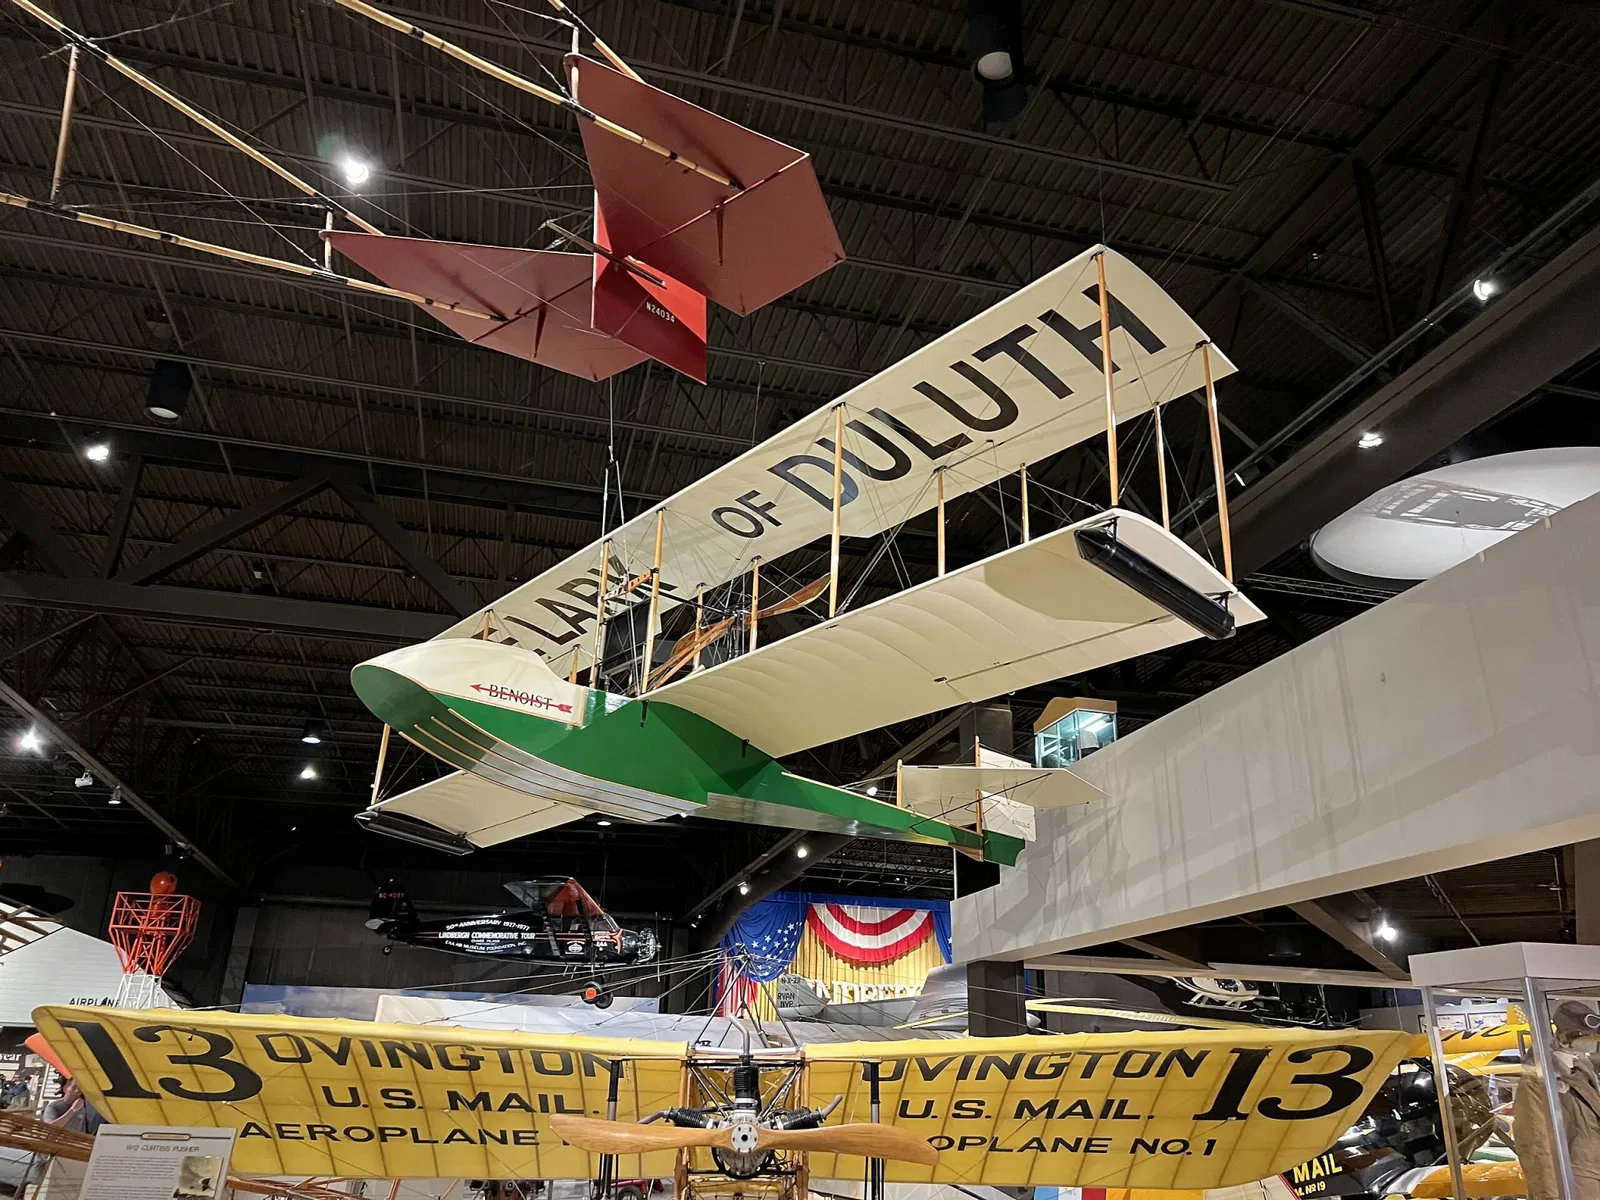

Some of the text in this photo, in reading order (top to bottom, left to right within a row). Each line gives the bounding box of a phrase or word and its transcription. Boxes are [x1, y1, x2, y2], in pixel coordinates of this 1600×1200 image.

[645, 301, 676, 323] N24034
[711, 489, 782, 538] OF
[767, 283, 1167, 512] DULUTH
[488, 684, 553, 710] BENOIST
[458, 919, 502, 928] ANNIVERSARY
[502, 921, 530, 931] 1927-1977
[486, 943, 516, 951] FOUNDATION
[777, 992, 795, 1000] RYAN
[58, 1020, 624, 1101] 13 OVINGTON
[863, 1045, 1374, 1121] OVINGTON 13
[446, 1089, 600, 1115] MAIL.
[1013, 1097, 1155, 1120] MAIL.
[239, 1122, 540, 1146] AEROPLANE
[926, 1135, 1113, 1155] OPLANE
[141, 1144, 171, 1152] CURTISS
[172, 1145, 200, 1153] PUSHER
[1293, 1153, 1343, 1184] MAIL
